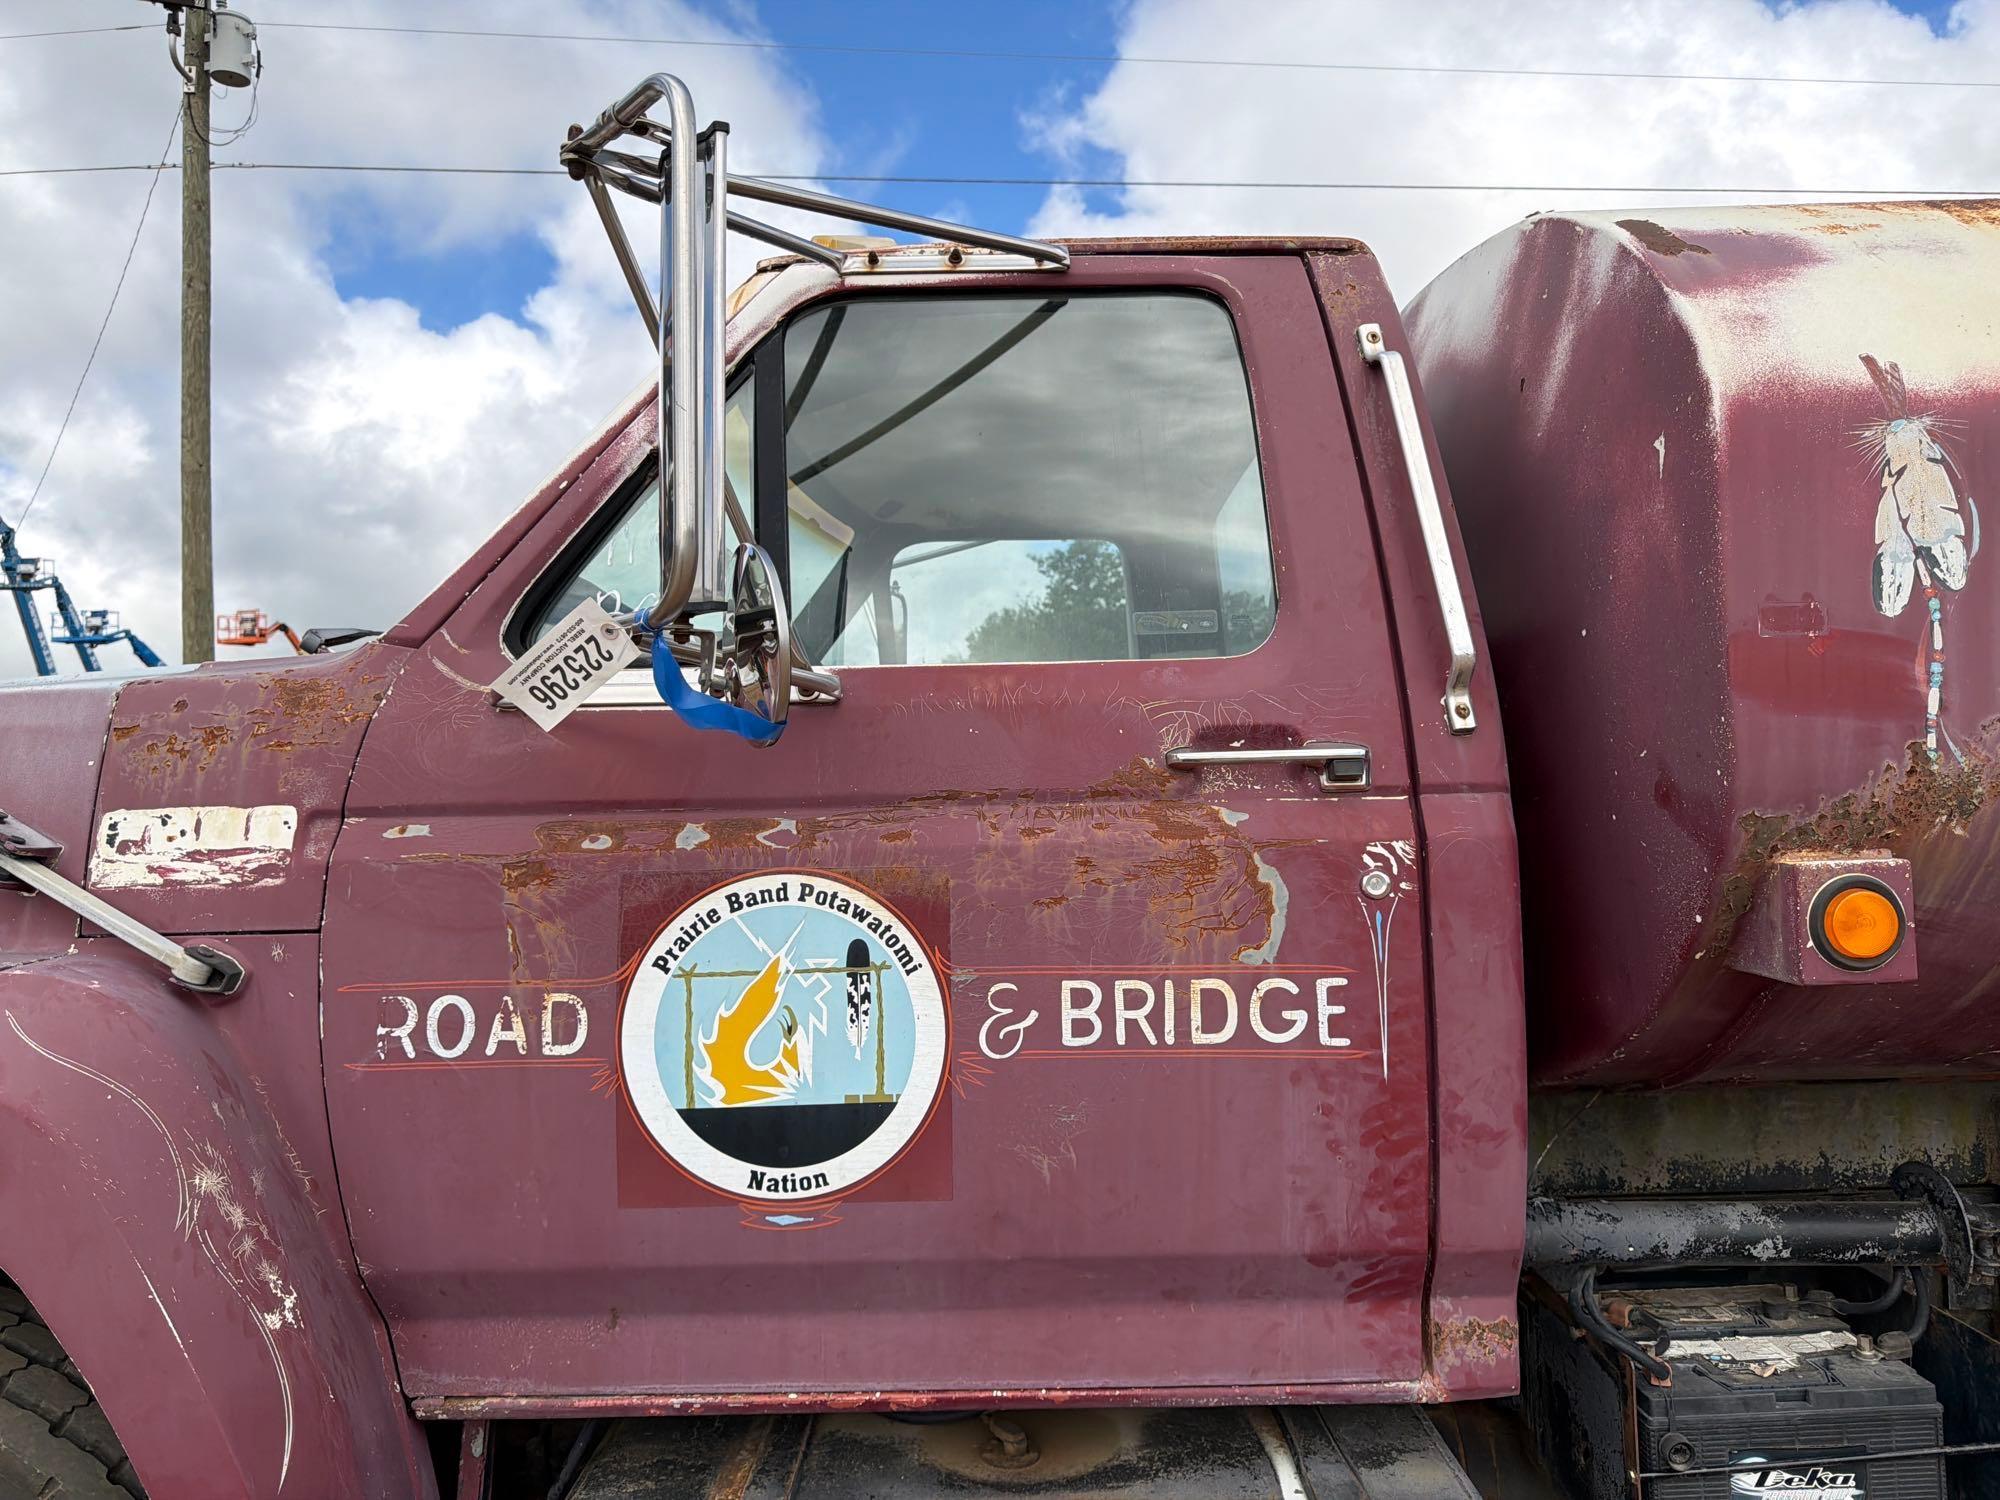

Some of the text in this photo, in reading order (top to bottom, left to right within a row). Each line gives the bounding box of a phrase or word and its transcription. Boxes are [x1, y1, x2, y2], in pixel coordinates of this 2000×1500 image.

[507, 643, 555, 686] www.rebelauction.com
[519, 627, 586, 687] REBEL AUCTION COMPANY
[528, 634, 614, 711] 225296
[651, 882, 924, 977] Prairie Band Potawatomi
[376, 994, 588, 1060] ROAD
[978, 977, 1352, 1060] & BRIDGE
[747, 1170, 830, 1193] Nation
[1754, 1467, 1854, 1489] Deka
